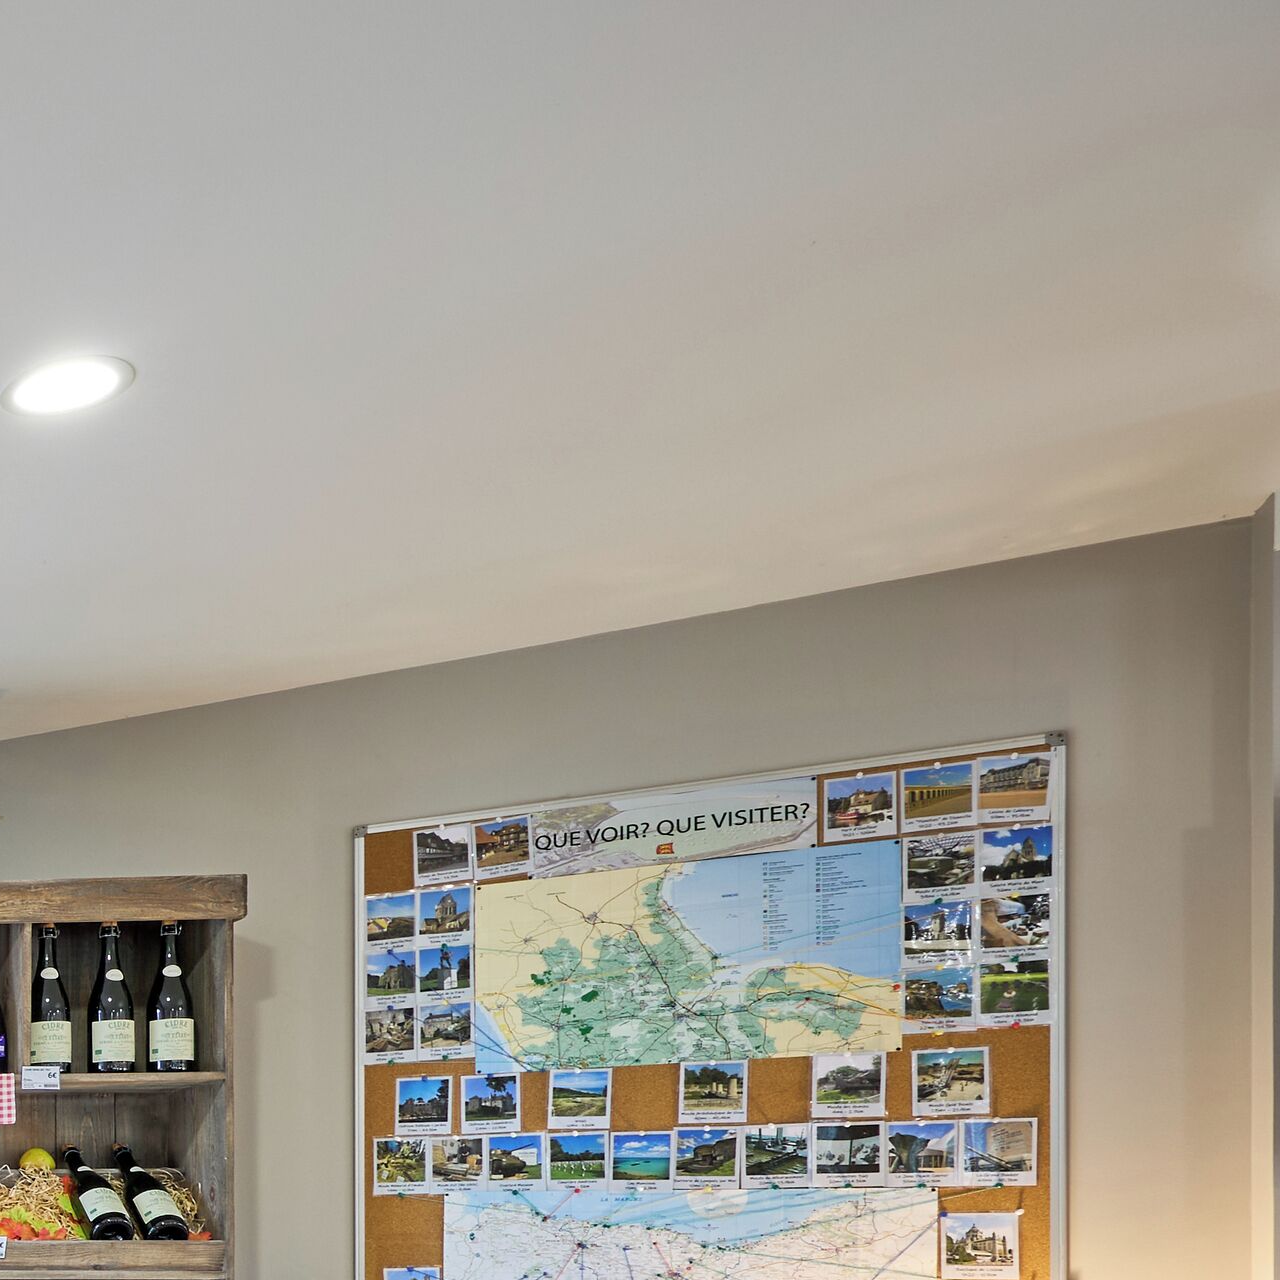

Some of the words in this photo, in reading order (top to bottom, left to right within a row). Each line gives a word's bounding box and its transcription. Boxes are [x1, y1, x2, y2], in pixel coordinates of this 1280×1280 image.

[534, 831, 582, 851] QUE
[586, 822, 650, 844] VOIR?
[656, 815, 707, 836] QUE
[712, 803, 810, 828] VISITER?
[41, 1021, 65, 1031] CIDRE
[108, 1020, 131, 1030] CIDRE
[164, 1019, 189, 1029] CIDRE
[47, 1071, 57, 1079] 6€
